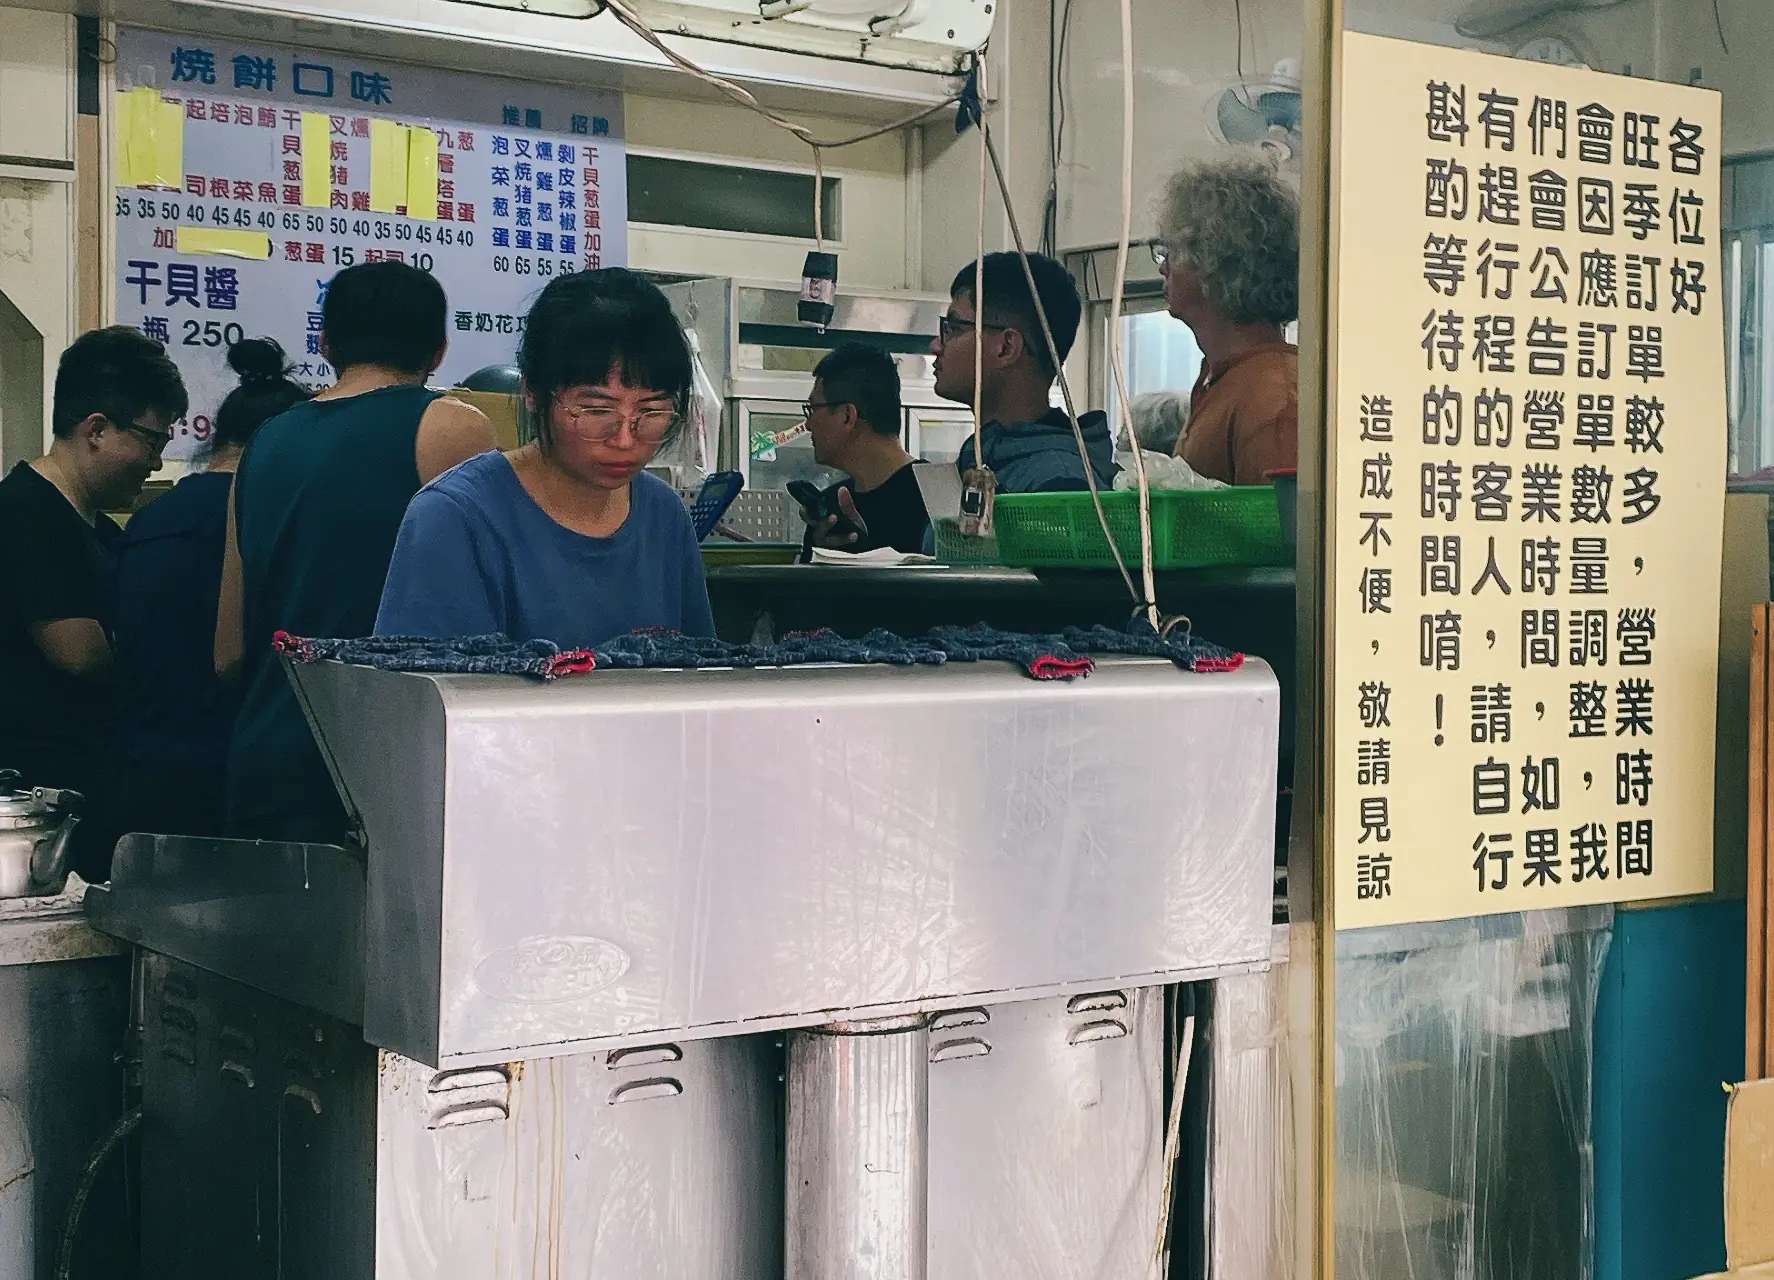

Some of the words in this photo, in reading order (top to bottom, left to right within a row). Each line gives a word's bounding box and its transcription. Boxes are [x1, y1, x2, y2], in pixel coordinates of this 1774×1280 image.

[170, 46, 393, 106] 燒餅口味
[138, 197, 156, 219] 35
[161, 202, 180, 220] 50
[186, 204, 204, 222] 40
[212, 205, 229, 226] 45
[234, 208, 251, 227] 45
[257, 211, 275, 228] 40
[282, 212, 300, 231] 65
[306, 216, 323, 233] 50
[330, 217, 347, 235] 50
[352, 220, 370, 237] 40
[374, 221, 391, 240] 35
[395, 224, 412, 241] 50
[415, 225, 432, 244] 45
[436, 227, 453, 246] 45
[456, 230, 474, 247] 40
[332, 245, 355, 267] 15
[410, 252, 434, 273] 10
[493, 256, 510, 273] 60
[515, 255, 531, 275] 65
[537, 257, 553, 277] 55
[1668, 116, 1707, 315] 各位好
[125, 260, 240, 311] 干貝醬
[182, 319, 245, 348] 250
[1470, 87, 1520, 893] 有趕行程的客人，請自行
[1520, 95, 1569, 888] 們會公告營業時間，如果
[1567, 102, 1619, 883] 會因應訂單數量調整，我
[1614, 111, 1667, 880] 旺季訂單較多，營業時間
[1356, 394, 1394, 900] 造成不便，敬請見諒
